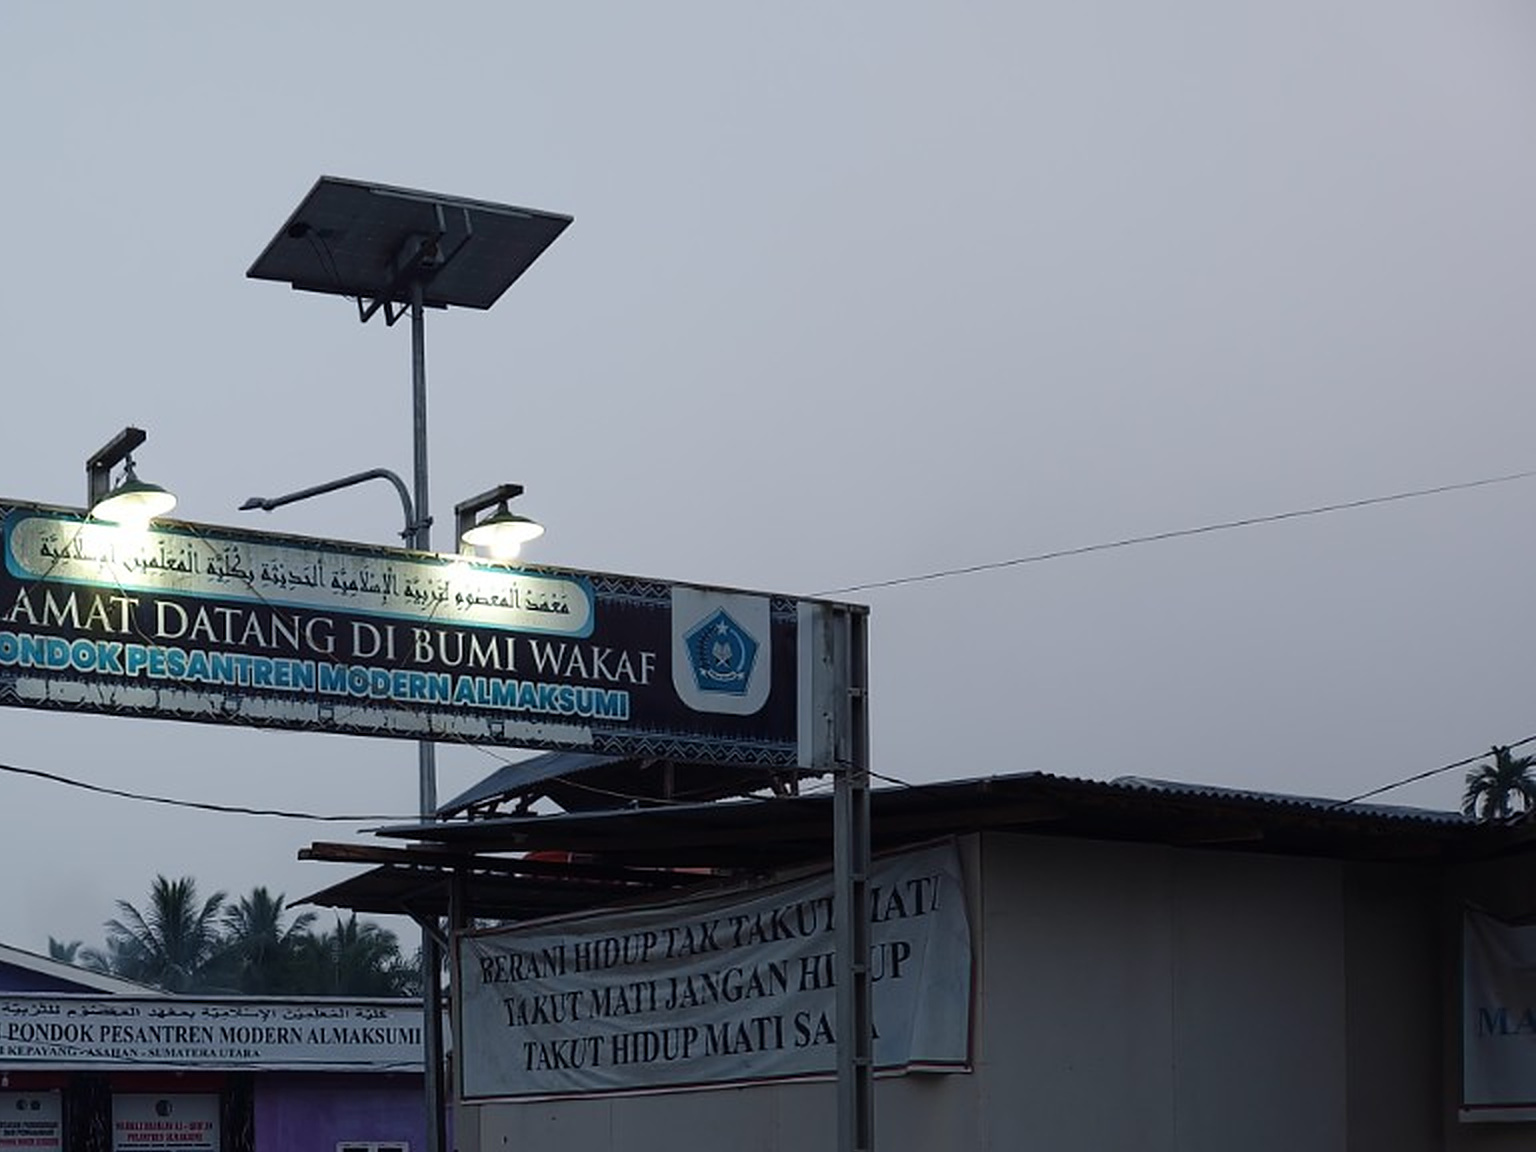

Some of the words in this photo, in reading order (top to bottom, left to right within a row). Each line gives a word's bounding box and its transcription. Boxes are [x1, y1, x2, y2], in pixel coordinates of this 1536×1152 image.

[125, 641, 314, 692] PESANTREN
[317, 661, 452, 705] MODERN
[452, 674, 631, 722] ALMAKSUMI
[154, 600, 335, 654] DATANG
[350, 620, 397, 661] DI
[412, 627, 518, 672] BUMI
[528, 639, 657, 685] WAKAF
[479, 946, 566, 985] BERANI
[572, 934, 658, 973] HIDUP
[662, 919, 723, 960] TAK
[729, 898, 835, 949] TAKUT
[503, 988, 580, 1028] TAKUT
[586, 981, 659, 1019] MATI
[663, 960, 790, 1011] JANGAN
[799, 940, 913, 989] HIUP
[7, 1022, 93, 1043] PONDOK
[99, 1023, 214, 1044] PESANTREN
[219, 1025, 303, 1045] MODERN
[307, 1026, 422, 1046] ALMAKSUMI
[523, 1035, 606, 1073] TAKUT
[611, 1026, 699, 1065] HIDUP
[704, 1014, 785, 1058] MATI
